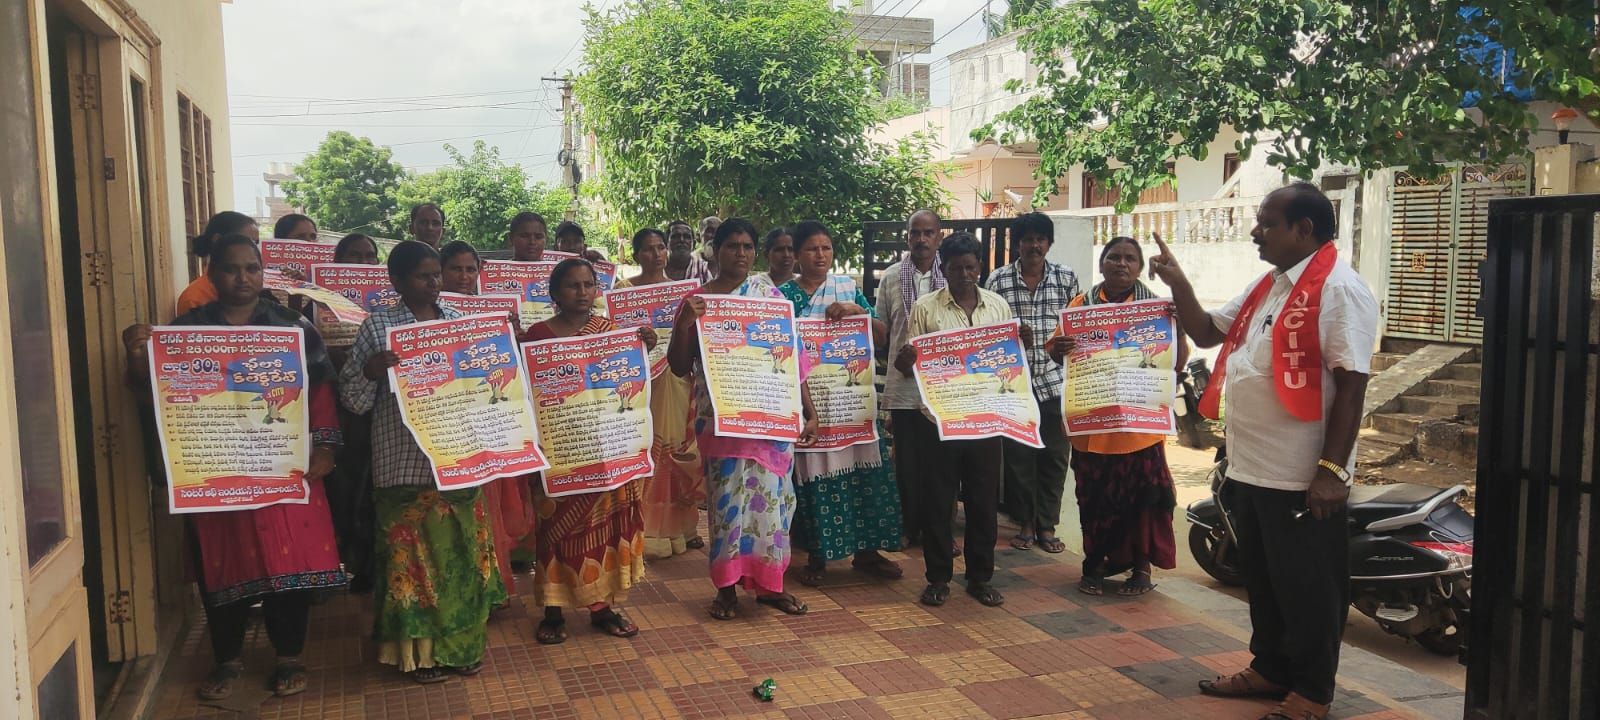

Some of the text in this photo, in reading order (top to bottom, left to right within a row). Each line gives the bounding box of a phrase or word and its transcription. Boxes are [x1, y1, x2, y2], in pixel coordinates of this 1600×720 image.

[159, 333, 184, 344] కనీస
[262, 332, 294, 343] పెంచాలి
[1282, 311, 1307, 389] CITU
